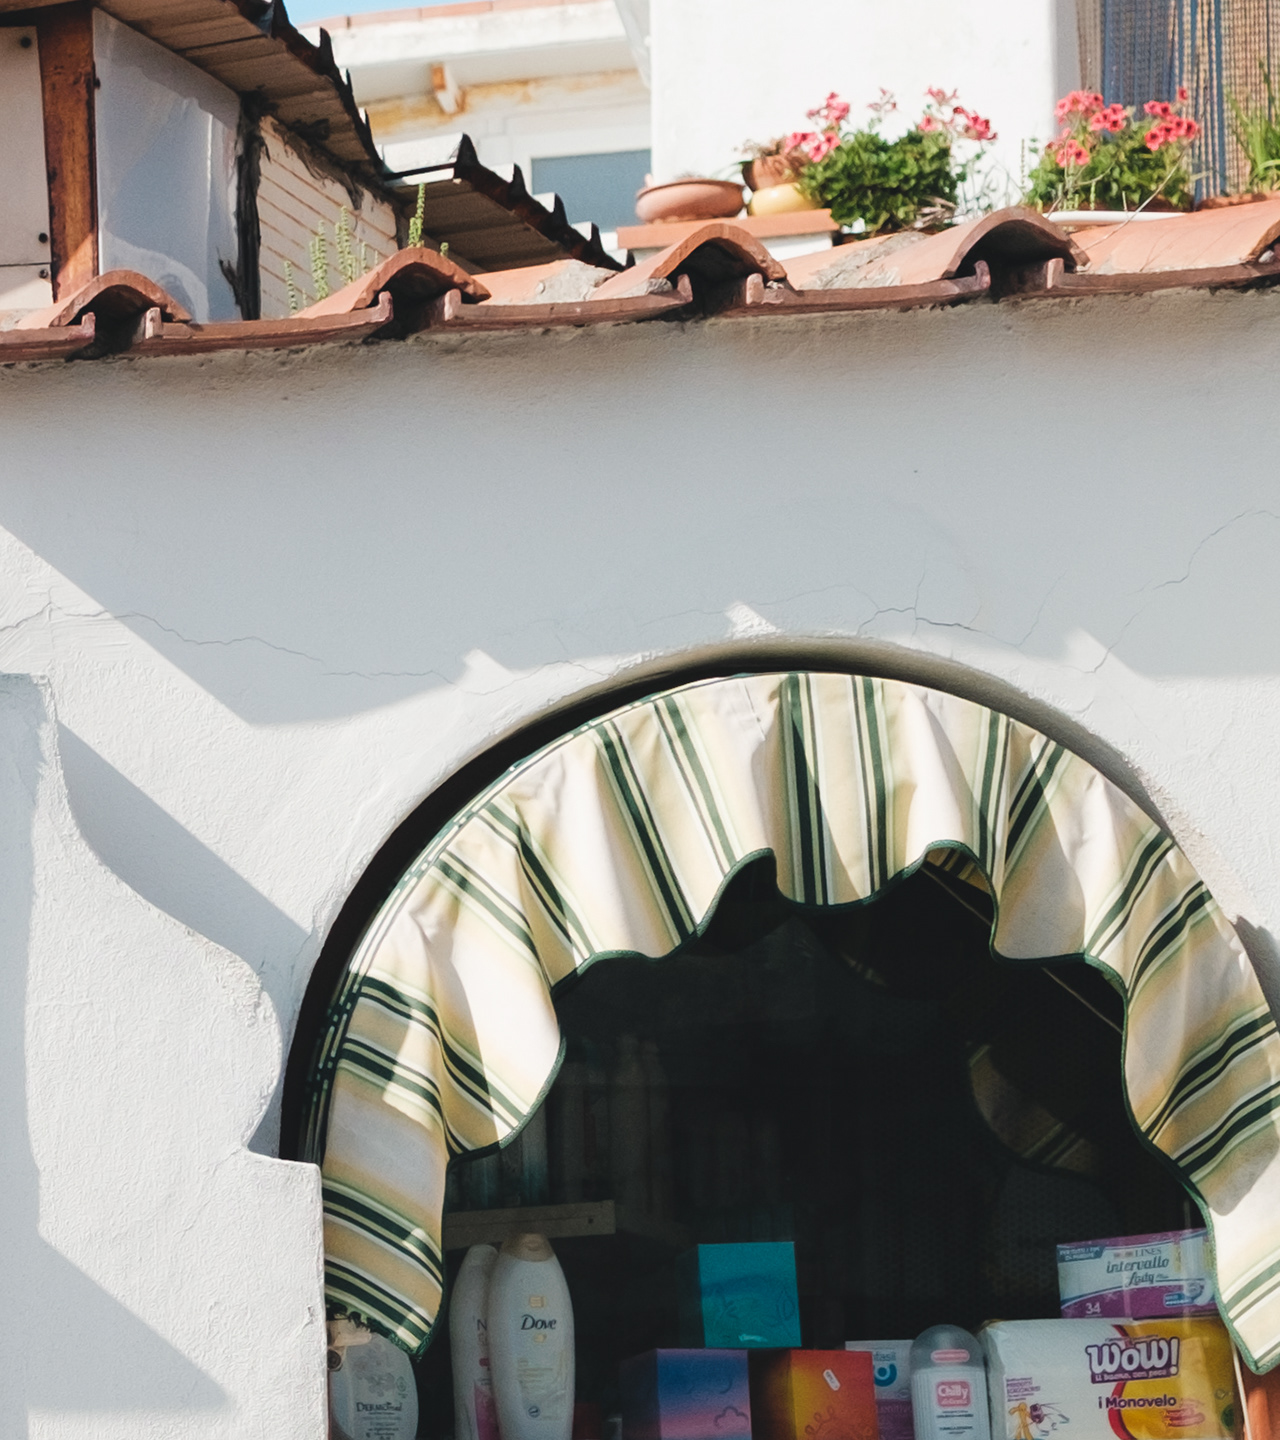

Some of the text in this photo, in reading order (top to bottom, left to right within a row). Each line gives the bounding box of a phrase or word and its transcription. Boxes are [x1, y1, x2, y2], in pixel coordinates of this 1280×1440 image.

[1106, 1256, 1170, 1274] intervallo
[1085, 1302, 1101, 1315] 34
[521, 1314, 557, 1331] Dove
[938, 1384, 969, 1400] Chilly
[1106, 1394, 1177, 1409] Monovelo
